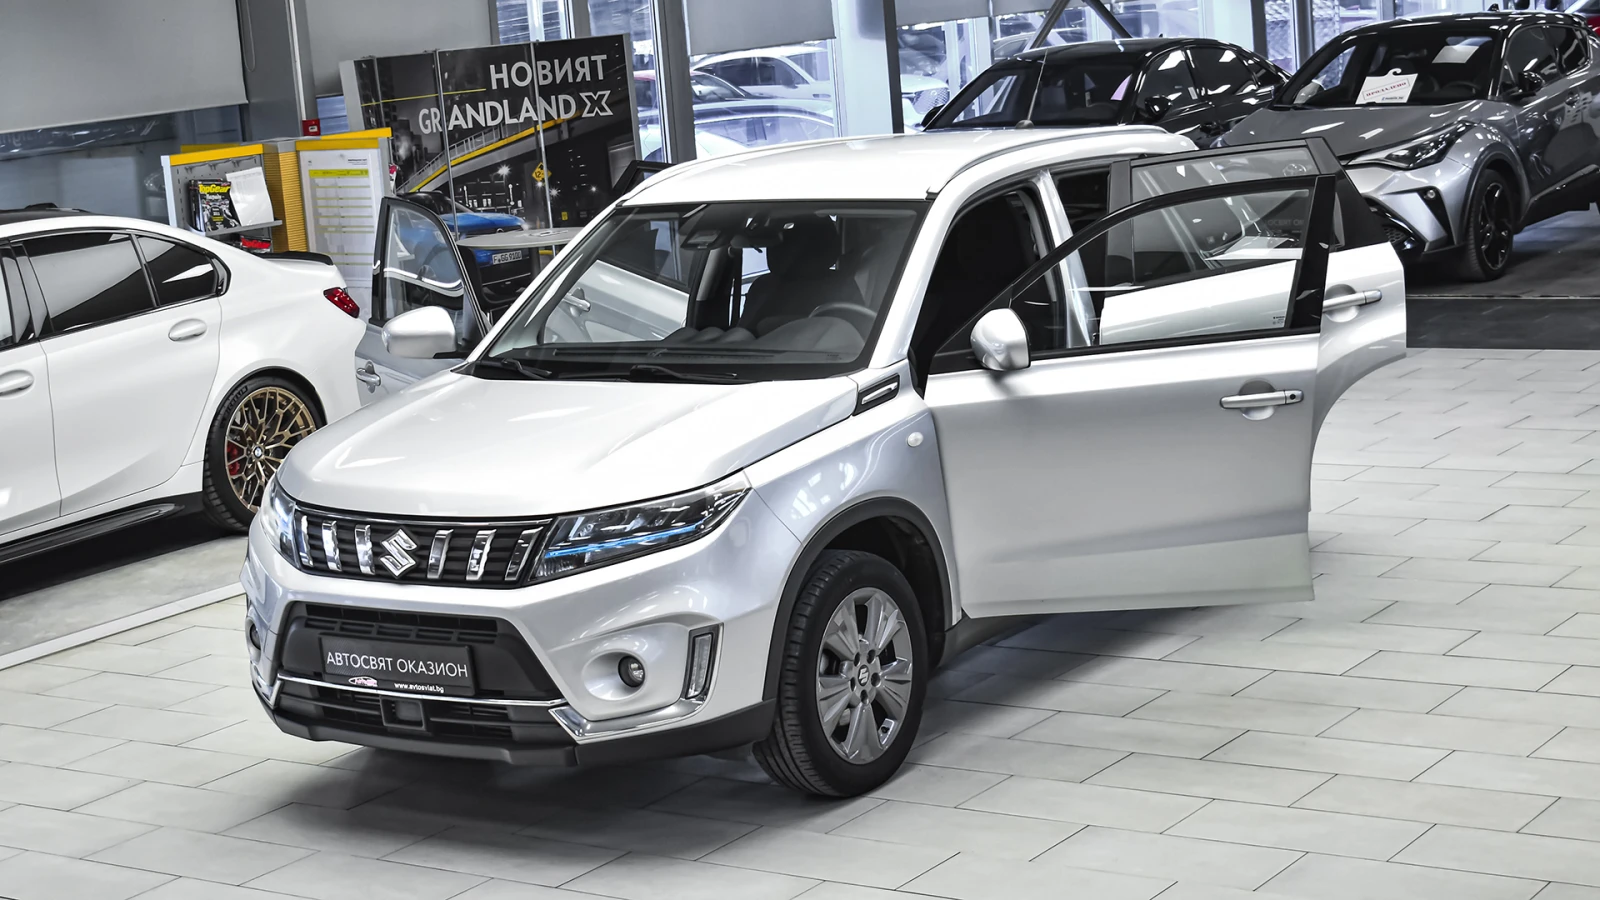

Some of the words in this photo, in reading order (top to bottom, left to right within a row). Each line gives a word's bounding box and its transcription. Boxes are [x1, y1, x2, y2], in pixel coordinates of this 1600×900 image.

[489, 54, 607, 89] НОВИЯТ
[418, 92, 577, 135] GRANDLAND
[579, 90, 613, 118] X
[198, 184, 231, 194] TopGear
[326, 651, 393, 671] АВТОСВЯТ
[396, 658, 468, 677] ОКАЗИОН
